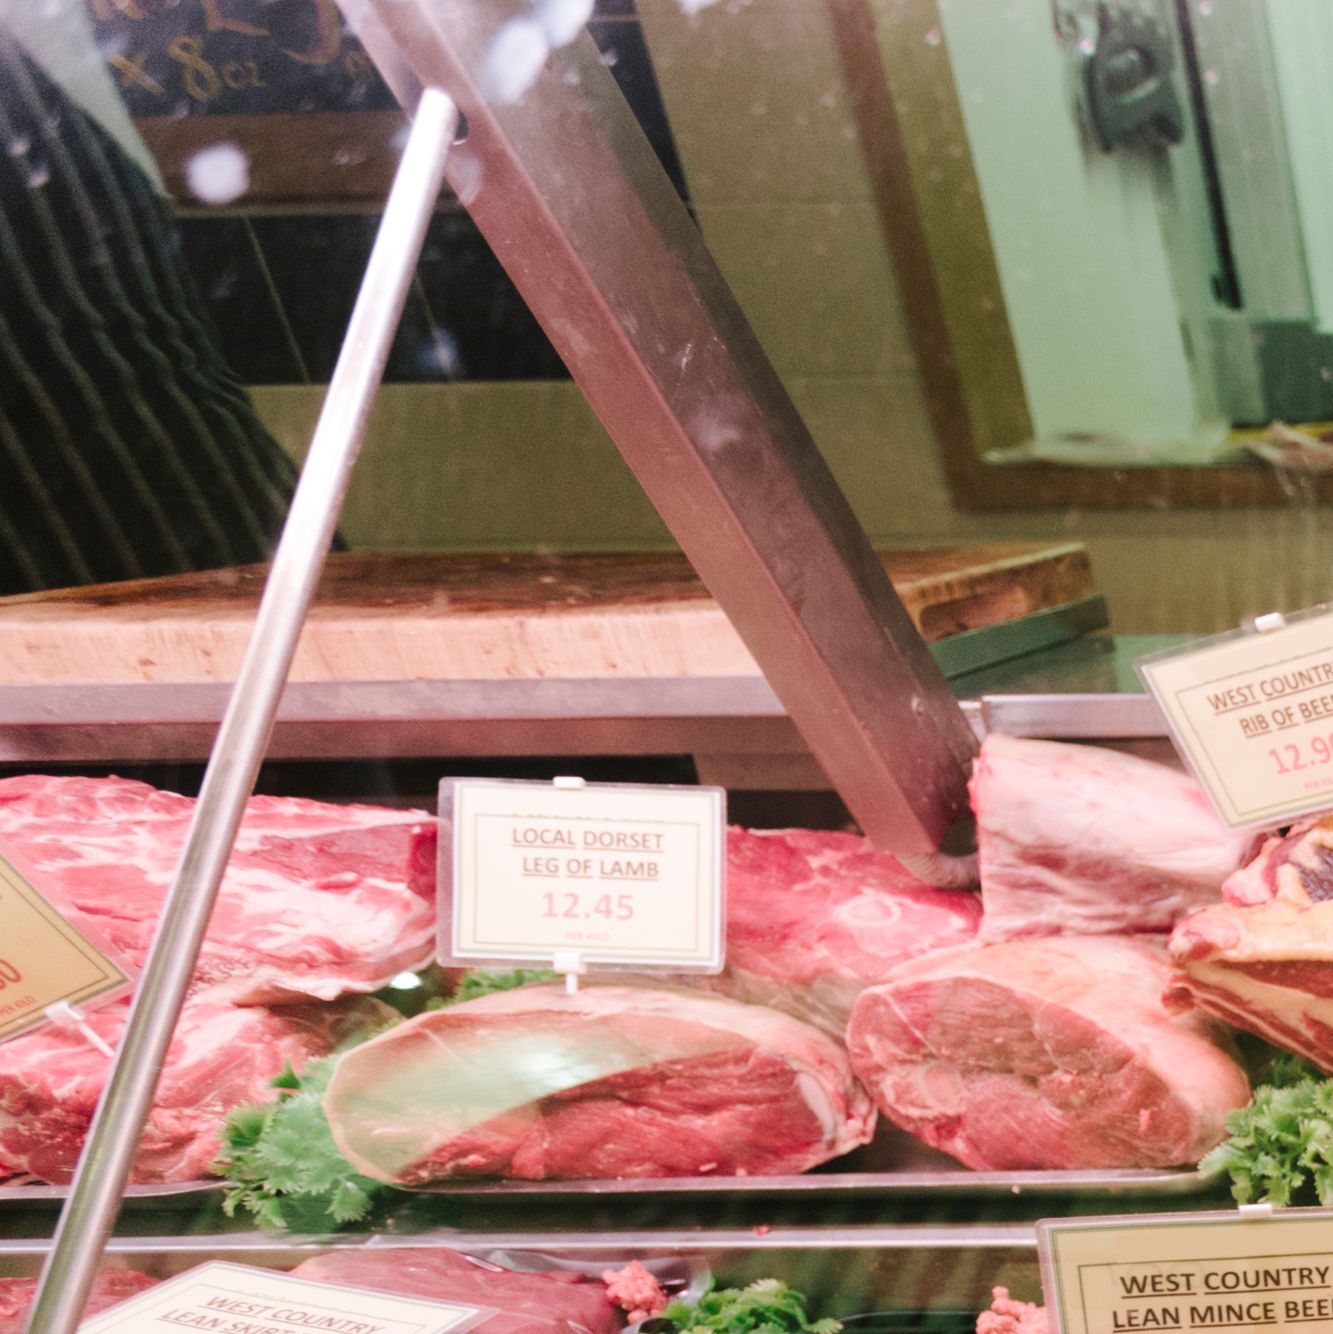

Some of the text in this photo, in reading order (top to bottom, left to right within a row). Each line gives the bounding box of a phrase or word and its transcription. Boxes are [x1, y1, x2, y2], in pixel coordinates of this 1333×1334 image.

[1207, 684, 1257, 711] WEST
[1239, 714, 1270, 735] RIB
[1272, 708, 1296, 727] OF
[512, 828, 664, 849] LOCAL DORSET
[523, 857, 659, 877] LEG OF LAMB
[541, 892, 635, 921] 12.45
[1120, 1266, 1330, 1294] WEST COUNTRY
[161, 1309, 227, 1329] LEAN
[206, 1296, 274, 1317] WEST
[1113, 1307, 1180, 1329] LEAN
[1189, 1301, 1275, 1324] MINCE
